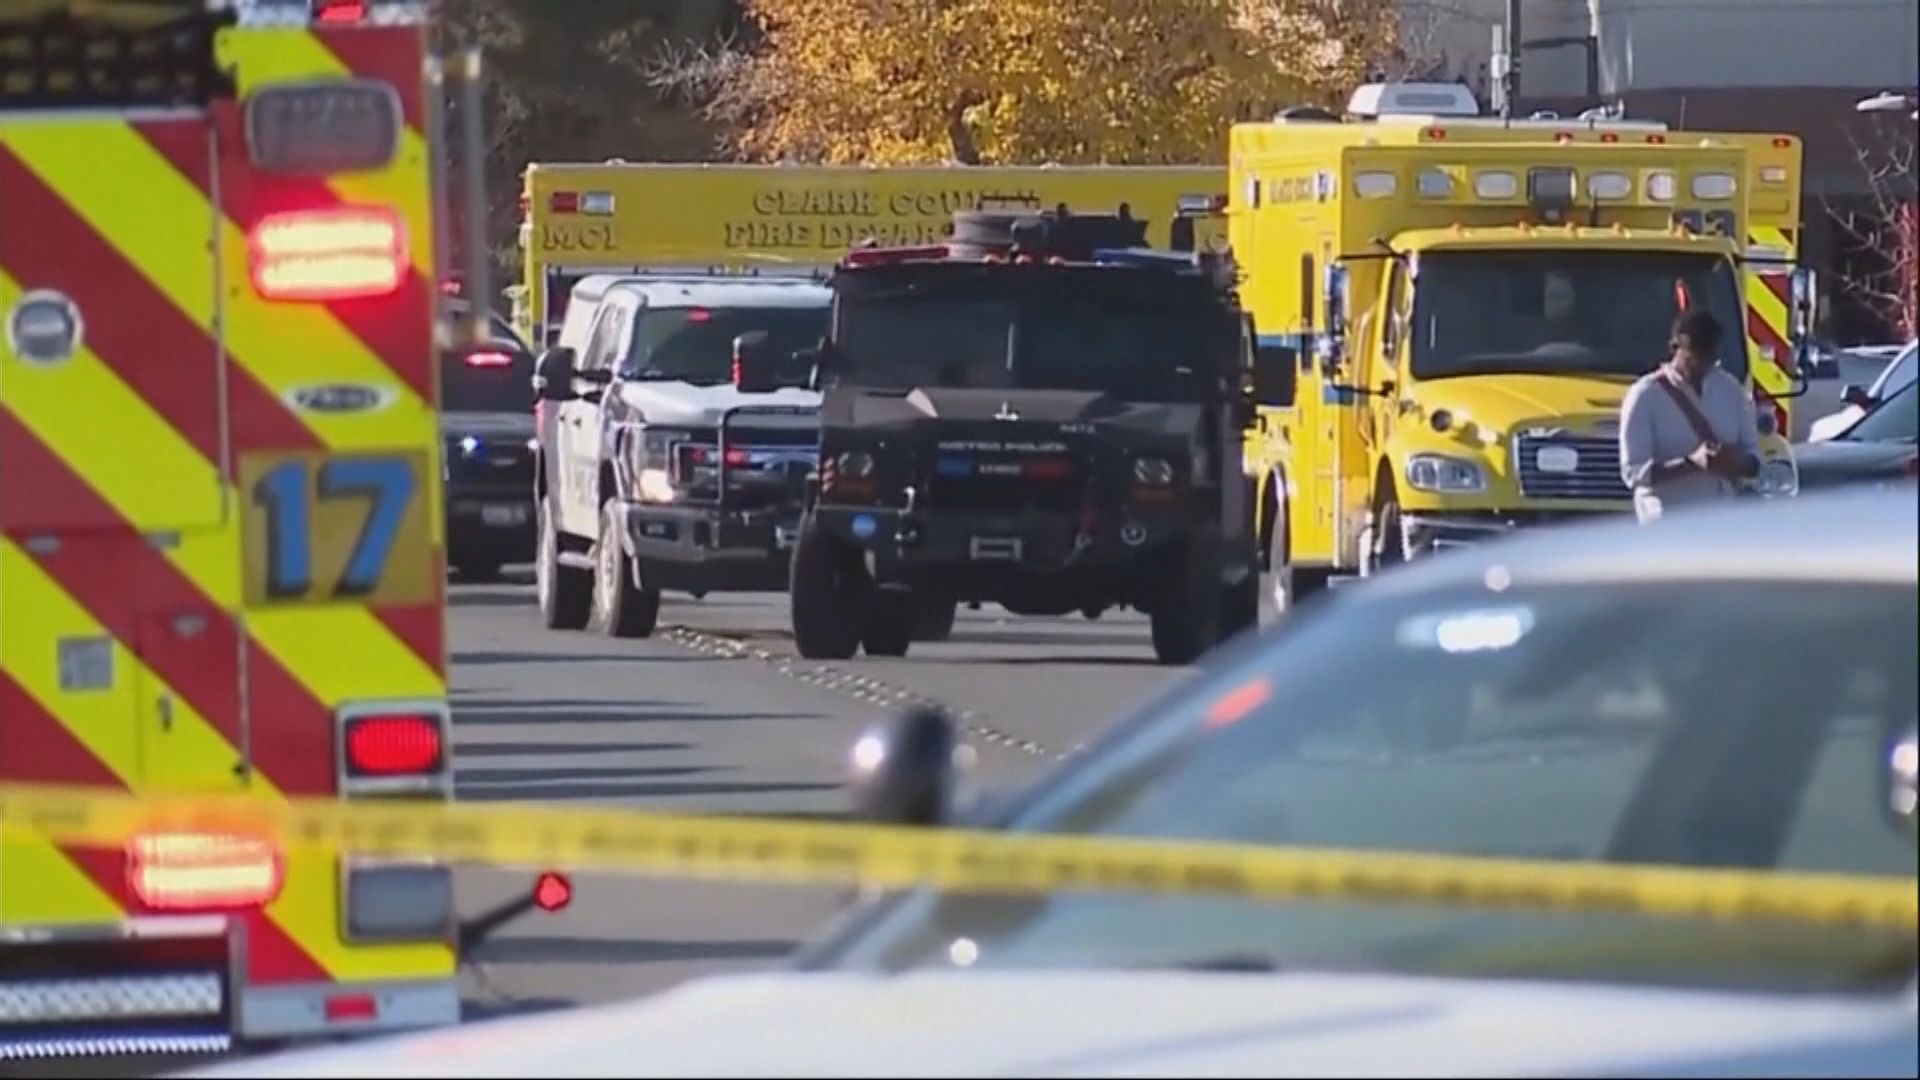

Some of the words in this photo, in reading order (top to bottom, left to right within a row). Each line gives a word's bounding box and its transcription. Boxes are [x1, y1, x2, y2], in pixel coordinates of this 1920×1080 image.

[754, 190, 880, 216] CLARK
[724, 222, 809, 249] FIRE
[253, 456, 417, 599] 17
